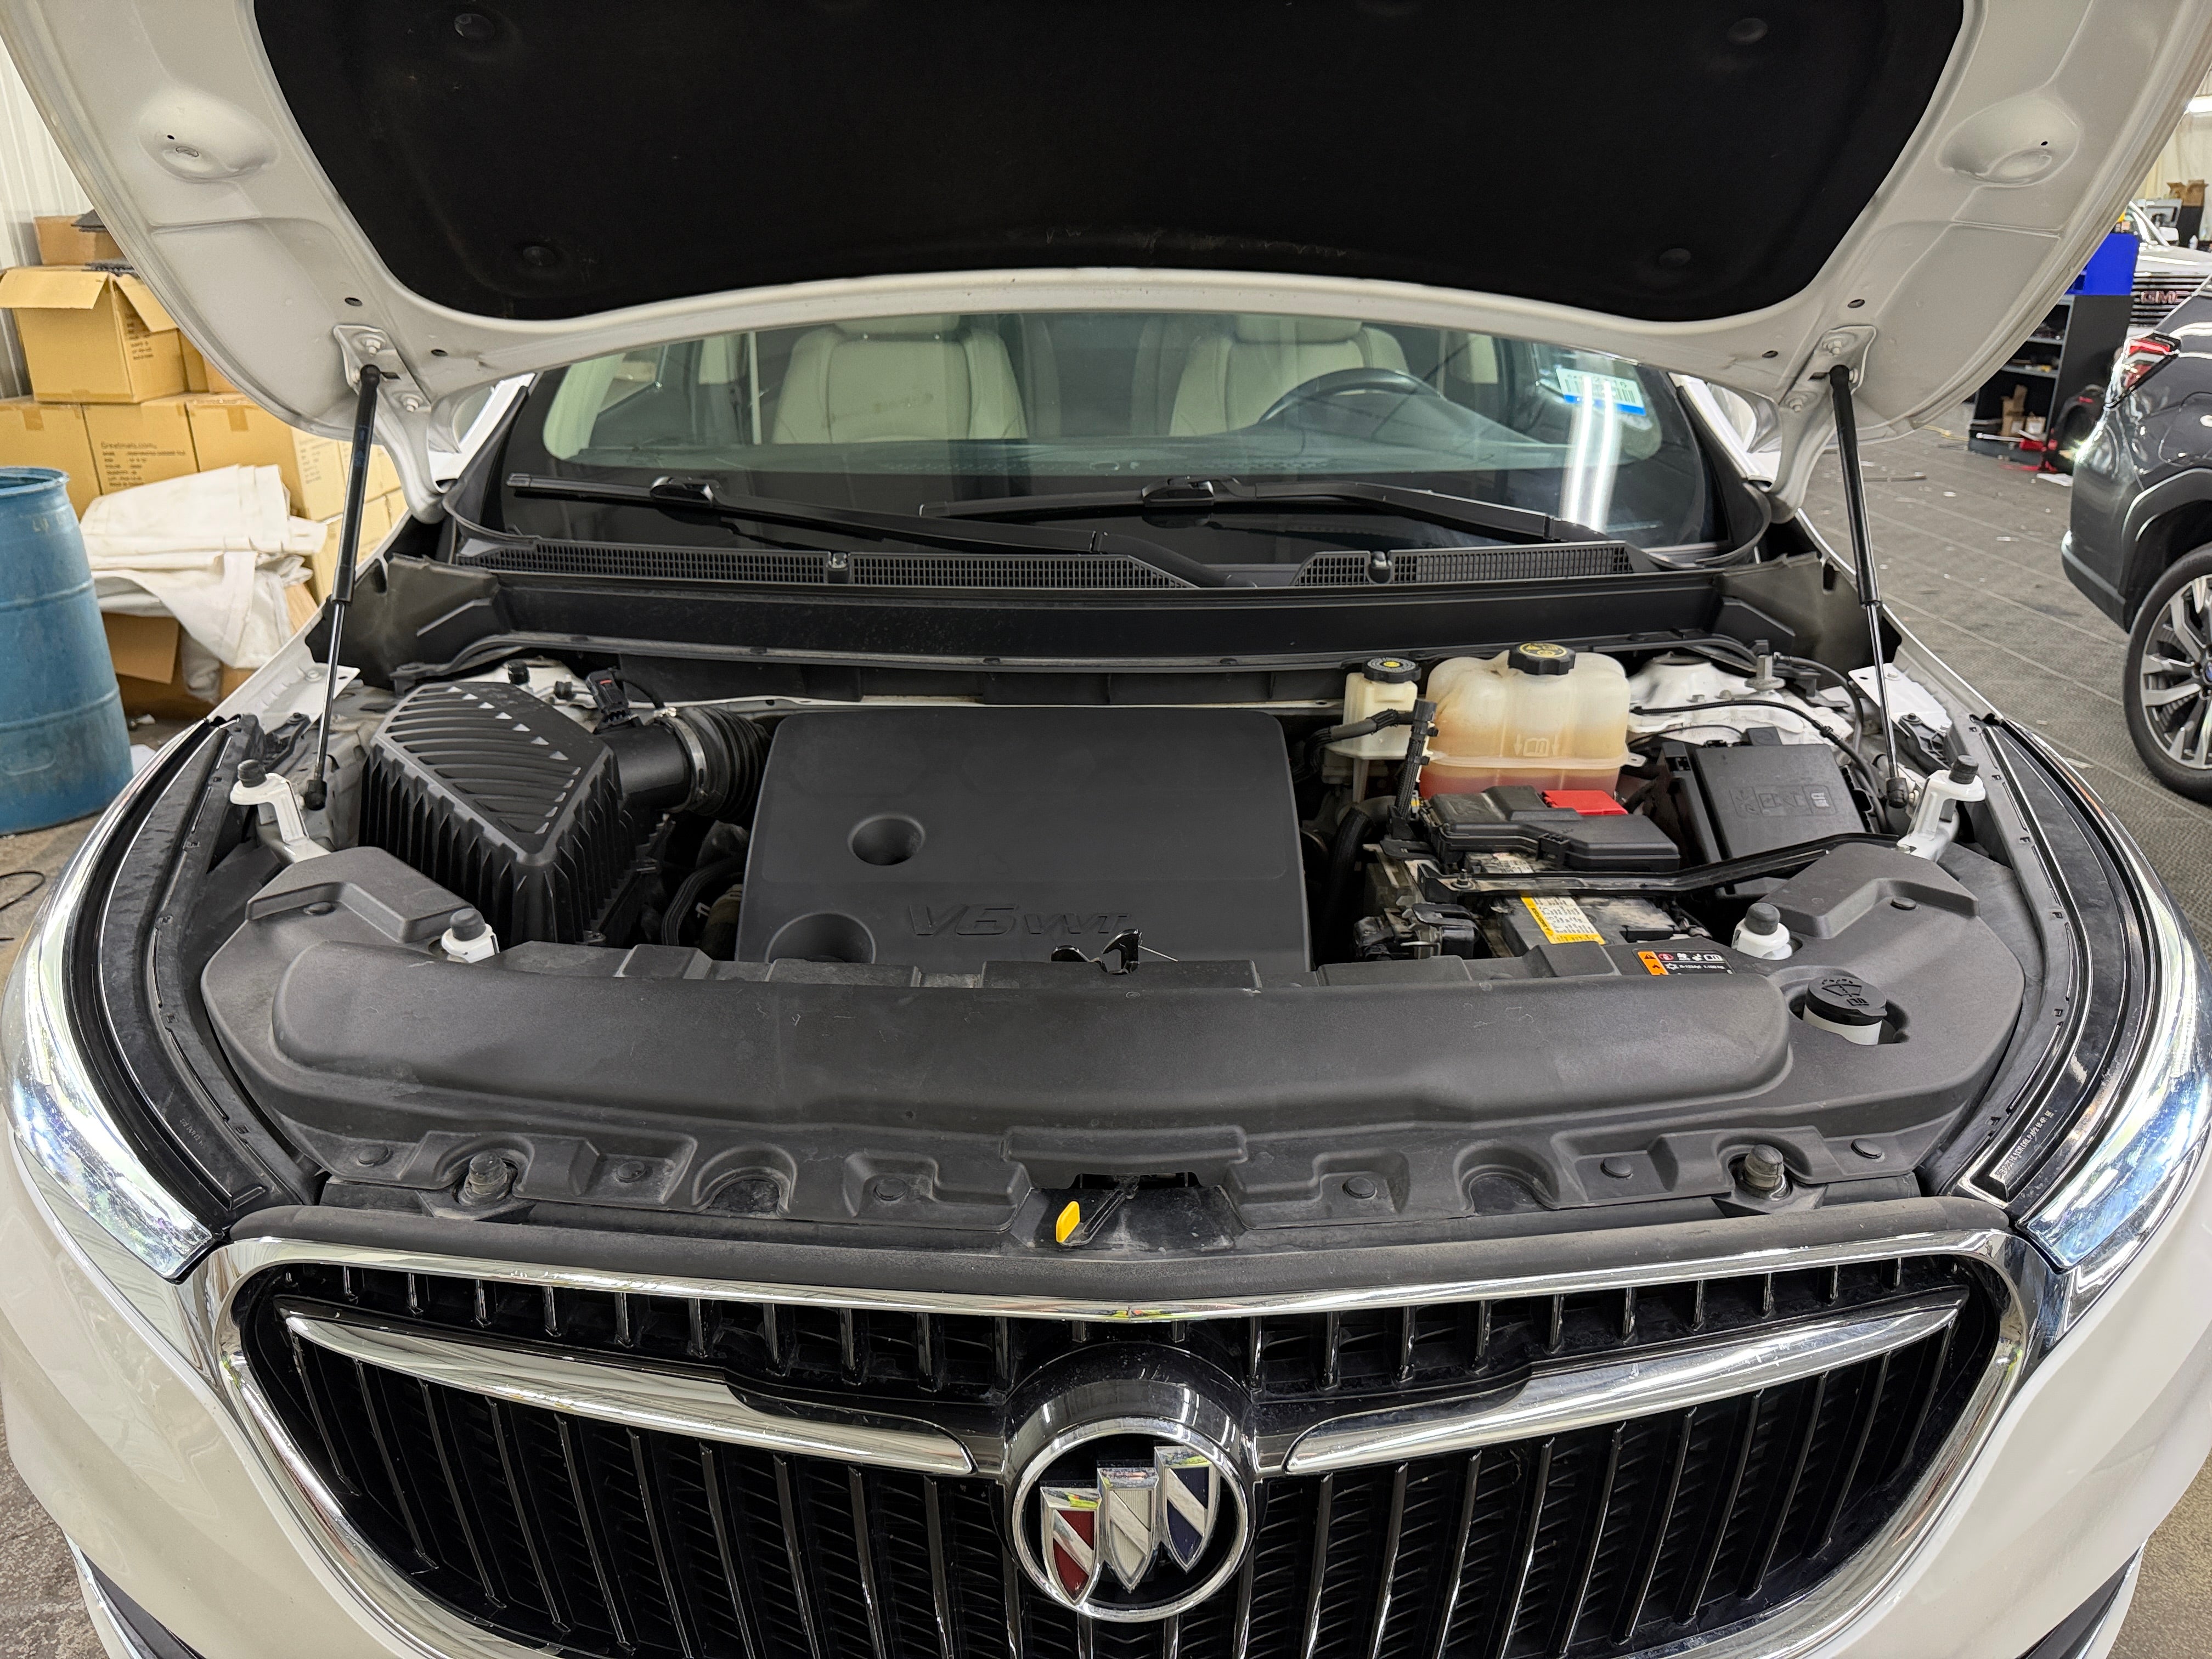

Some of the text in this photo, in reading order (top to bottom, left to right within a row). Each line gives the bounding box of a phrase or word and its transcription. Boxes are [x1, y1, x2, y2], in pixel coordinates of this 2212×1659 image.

[2141, 290, 2191, 304] GMC
[909, 903, 1130, 936] V6 VVT
